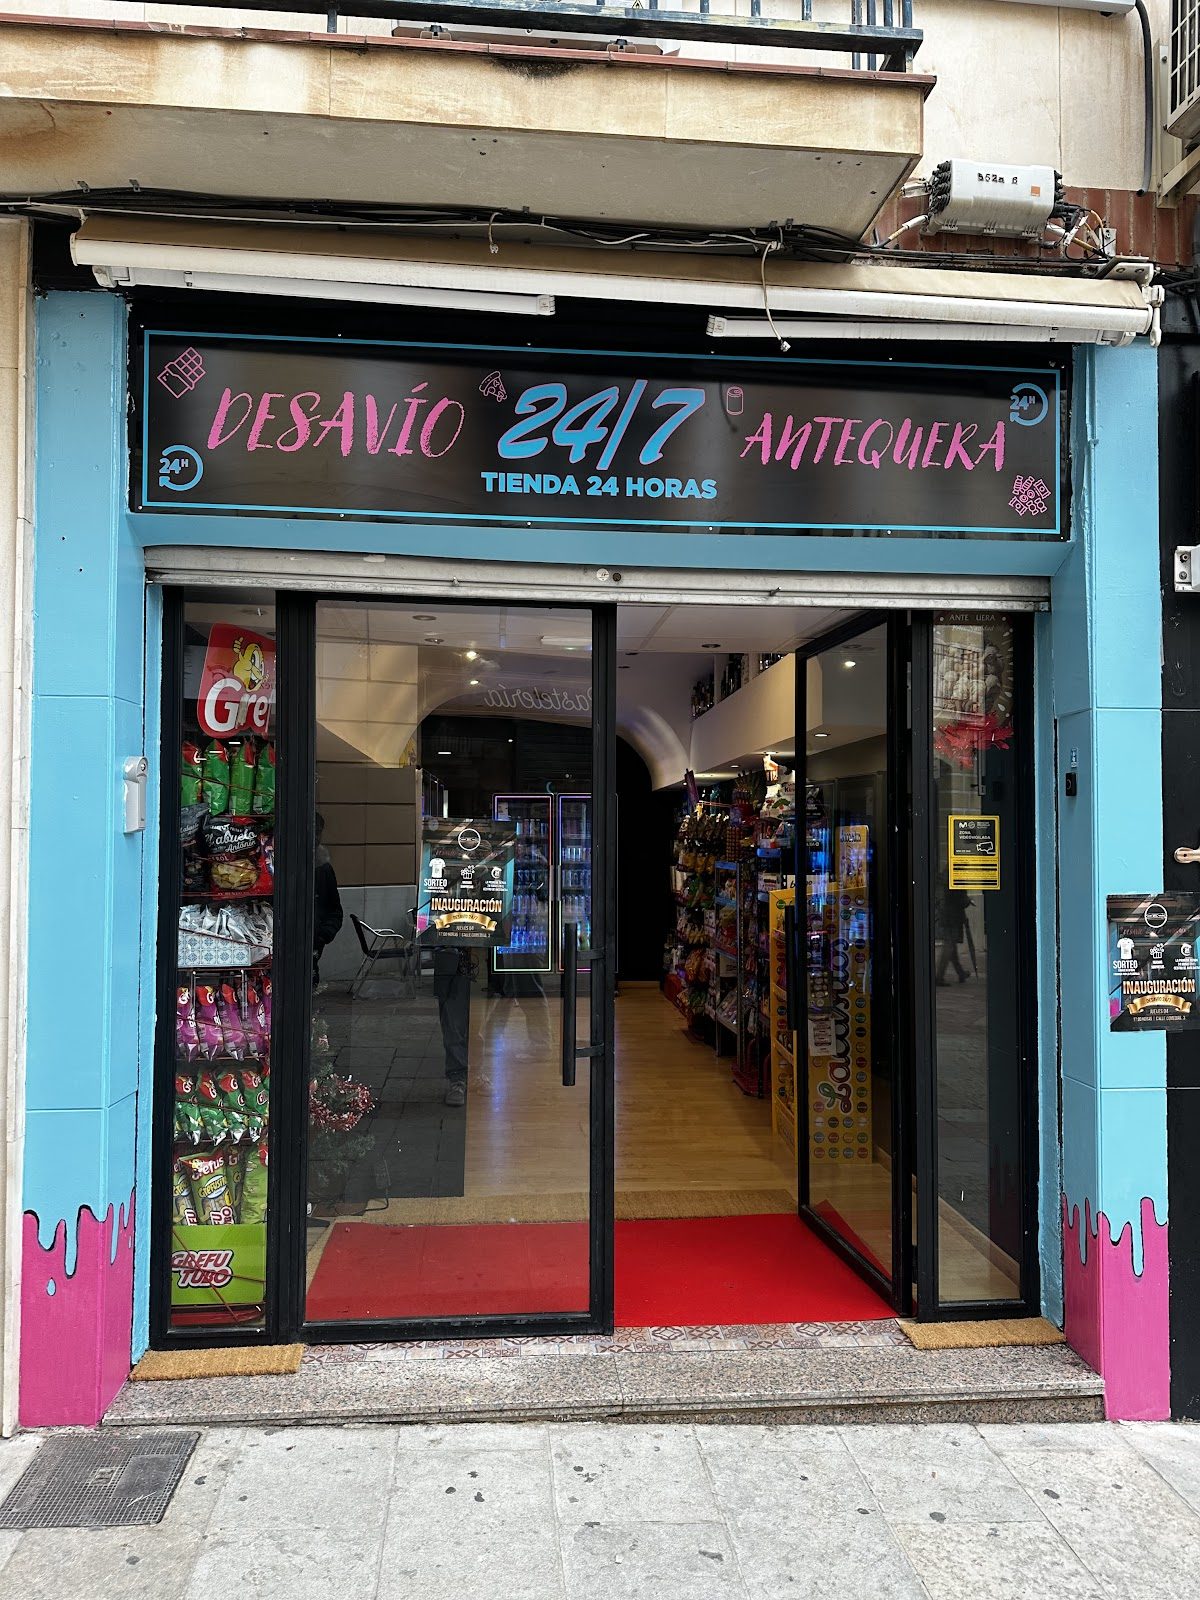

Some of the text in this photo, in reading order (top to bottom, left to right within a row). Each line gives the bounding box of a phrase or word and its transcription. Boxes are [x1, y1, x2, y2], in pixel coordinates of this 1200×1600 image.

[206, 379, 1006, 472] DESAVÍO 24/7 ANTEQUERA
[480, 471, 718, 499] TIENDA 24 HORAS
[423, 878, 448, 888] SORTEO
[430, 897, 503, 913] INAUGURACIÓN
[1112, 959, 1139, 969] SORTEO
[1122, 977, 1196, 995] INAUGURACIÓN
[172, 1251, 231, 1268] GREFU
[181, 1268, 231, 1286] TUBO
